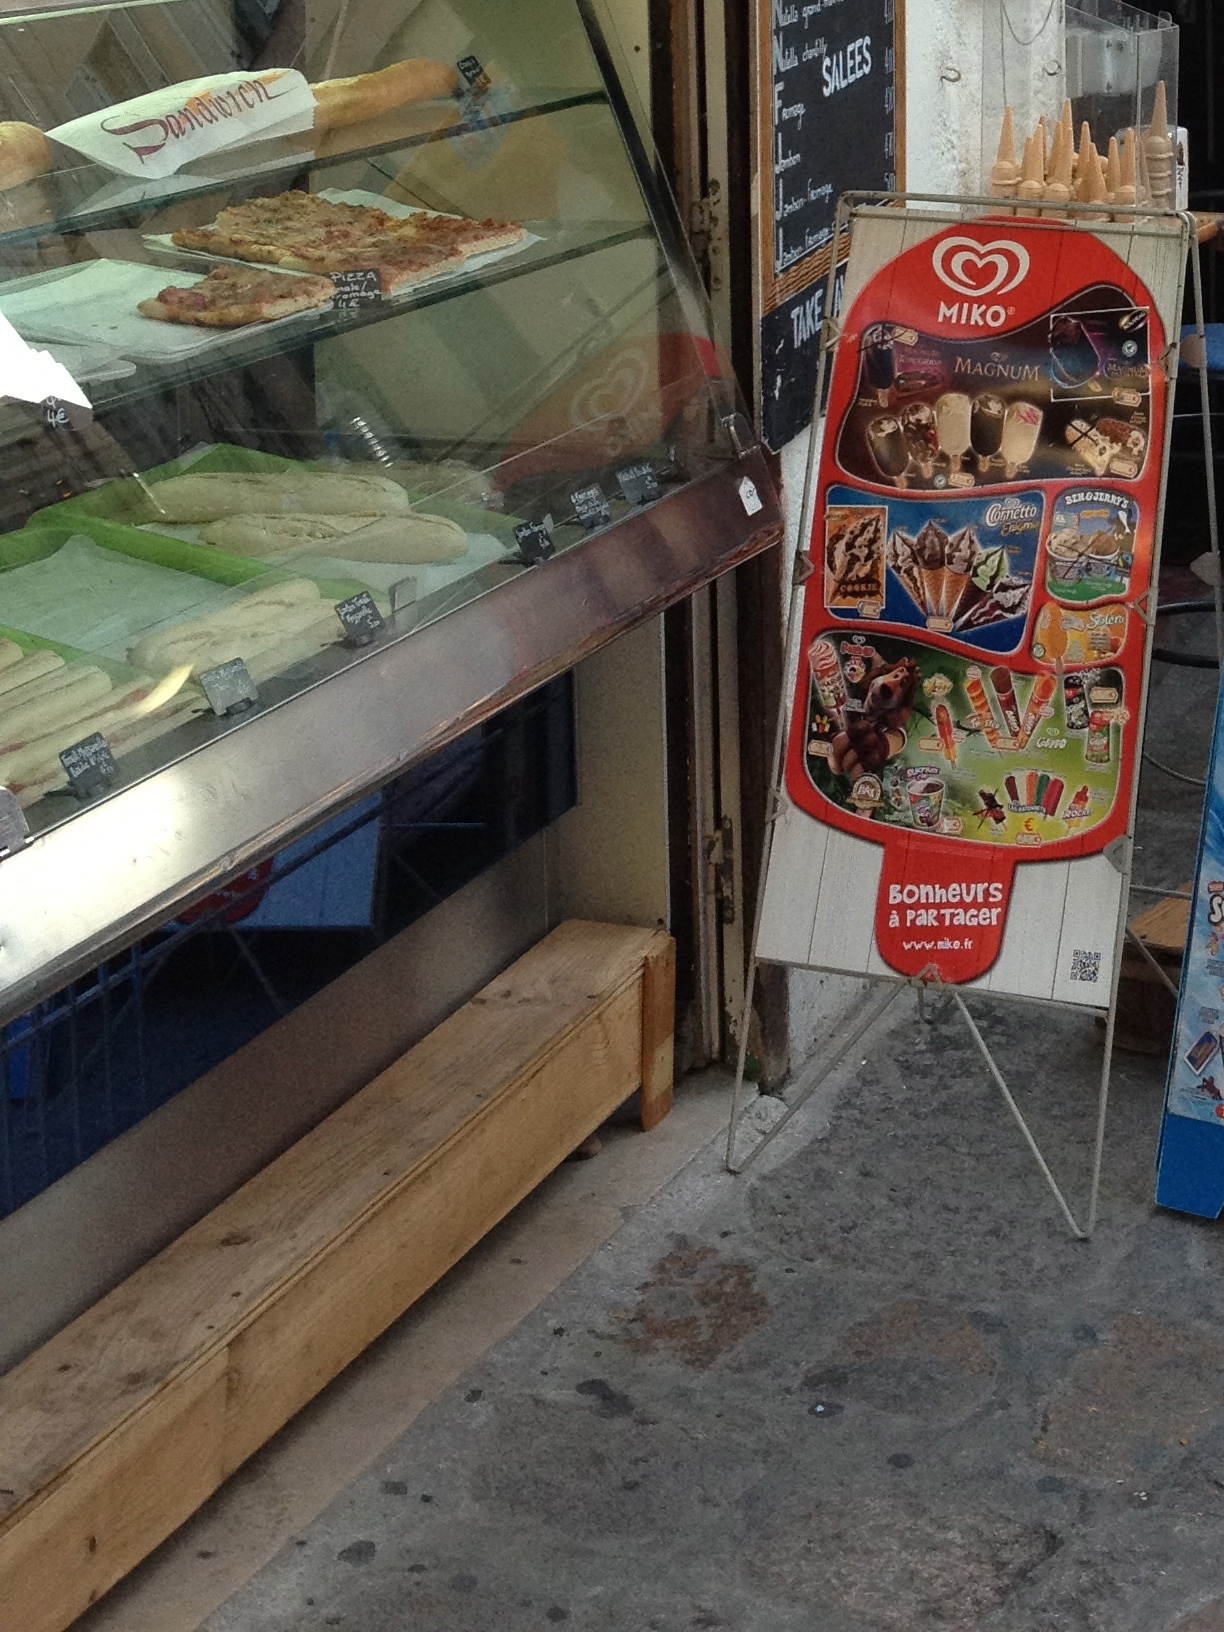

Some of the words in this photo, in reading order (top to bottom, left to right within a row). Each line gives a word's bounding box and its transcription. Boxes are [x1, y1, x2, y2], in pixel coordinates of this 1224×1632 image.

[822, 35, 873, 97] SALEES
[101, 76, 294, 164] Sandwich
[329, 271, 377, 282] PIZZA
[791, 288, 825, 348] TAKE
[937, 301, 1007, 328] MIKO
[954, 356, 1041, 381] MAGNUM
[985, 503, 1038, 527] Cornetto
[888, 909, 900, 928] à
[903, 937, 974, 951] www.miko.fr
